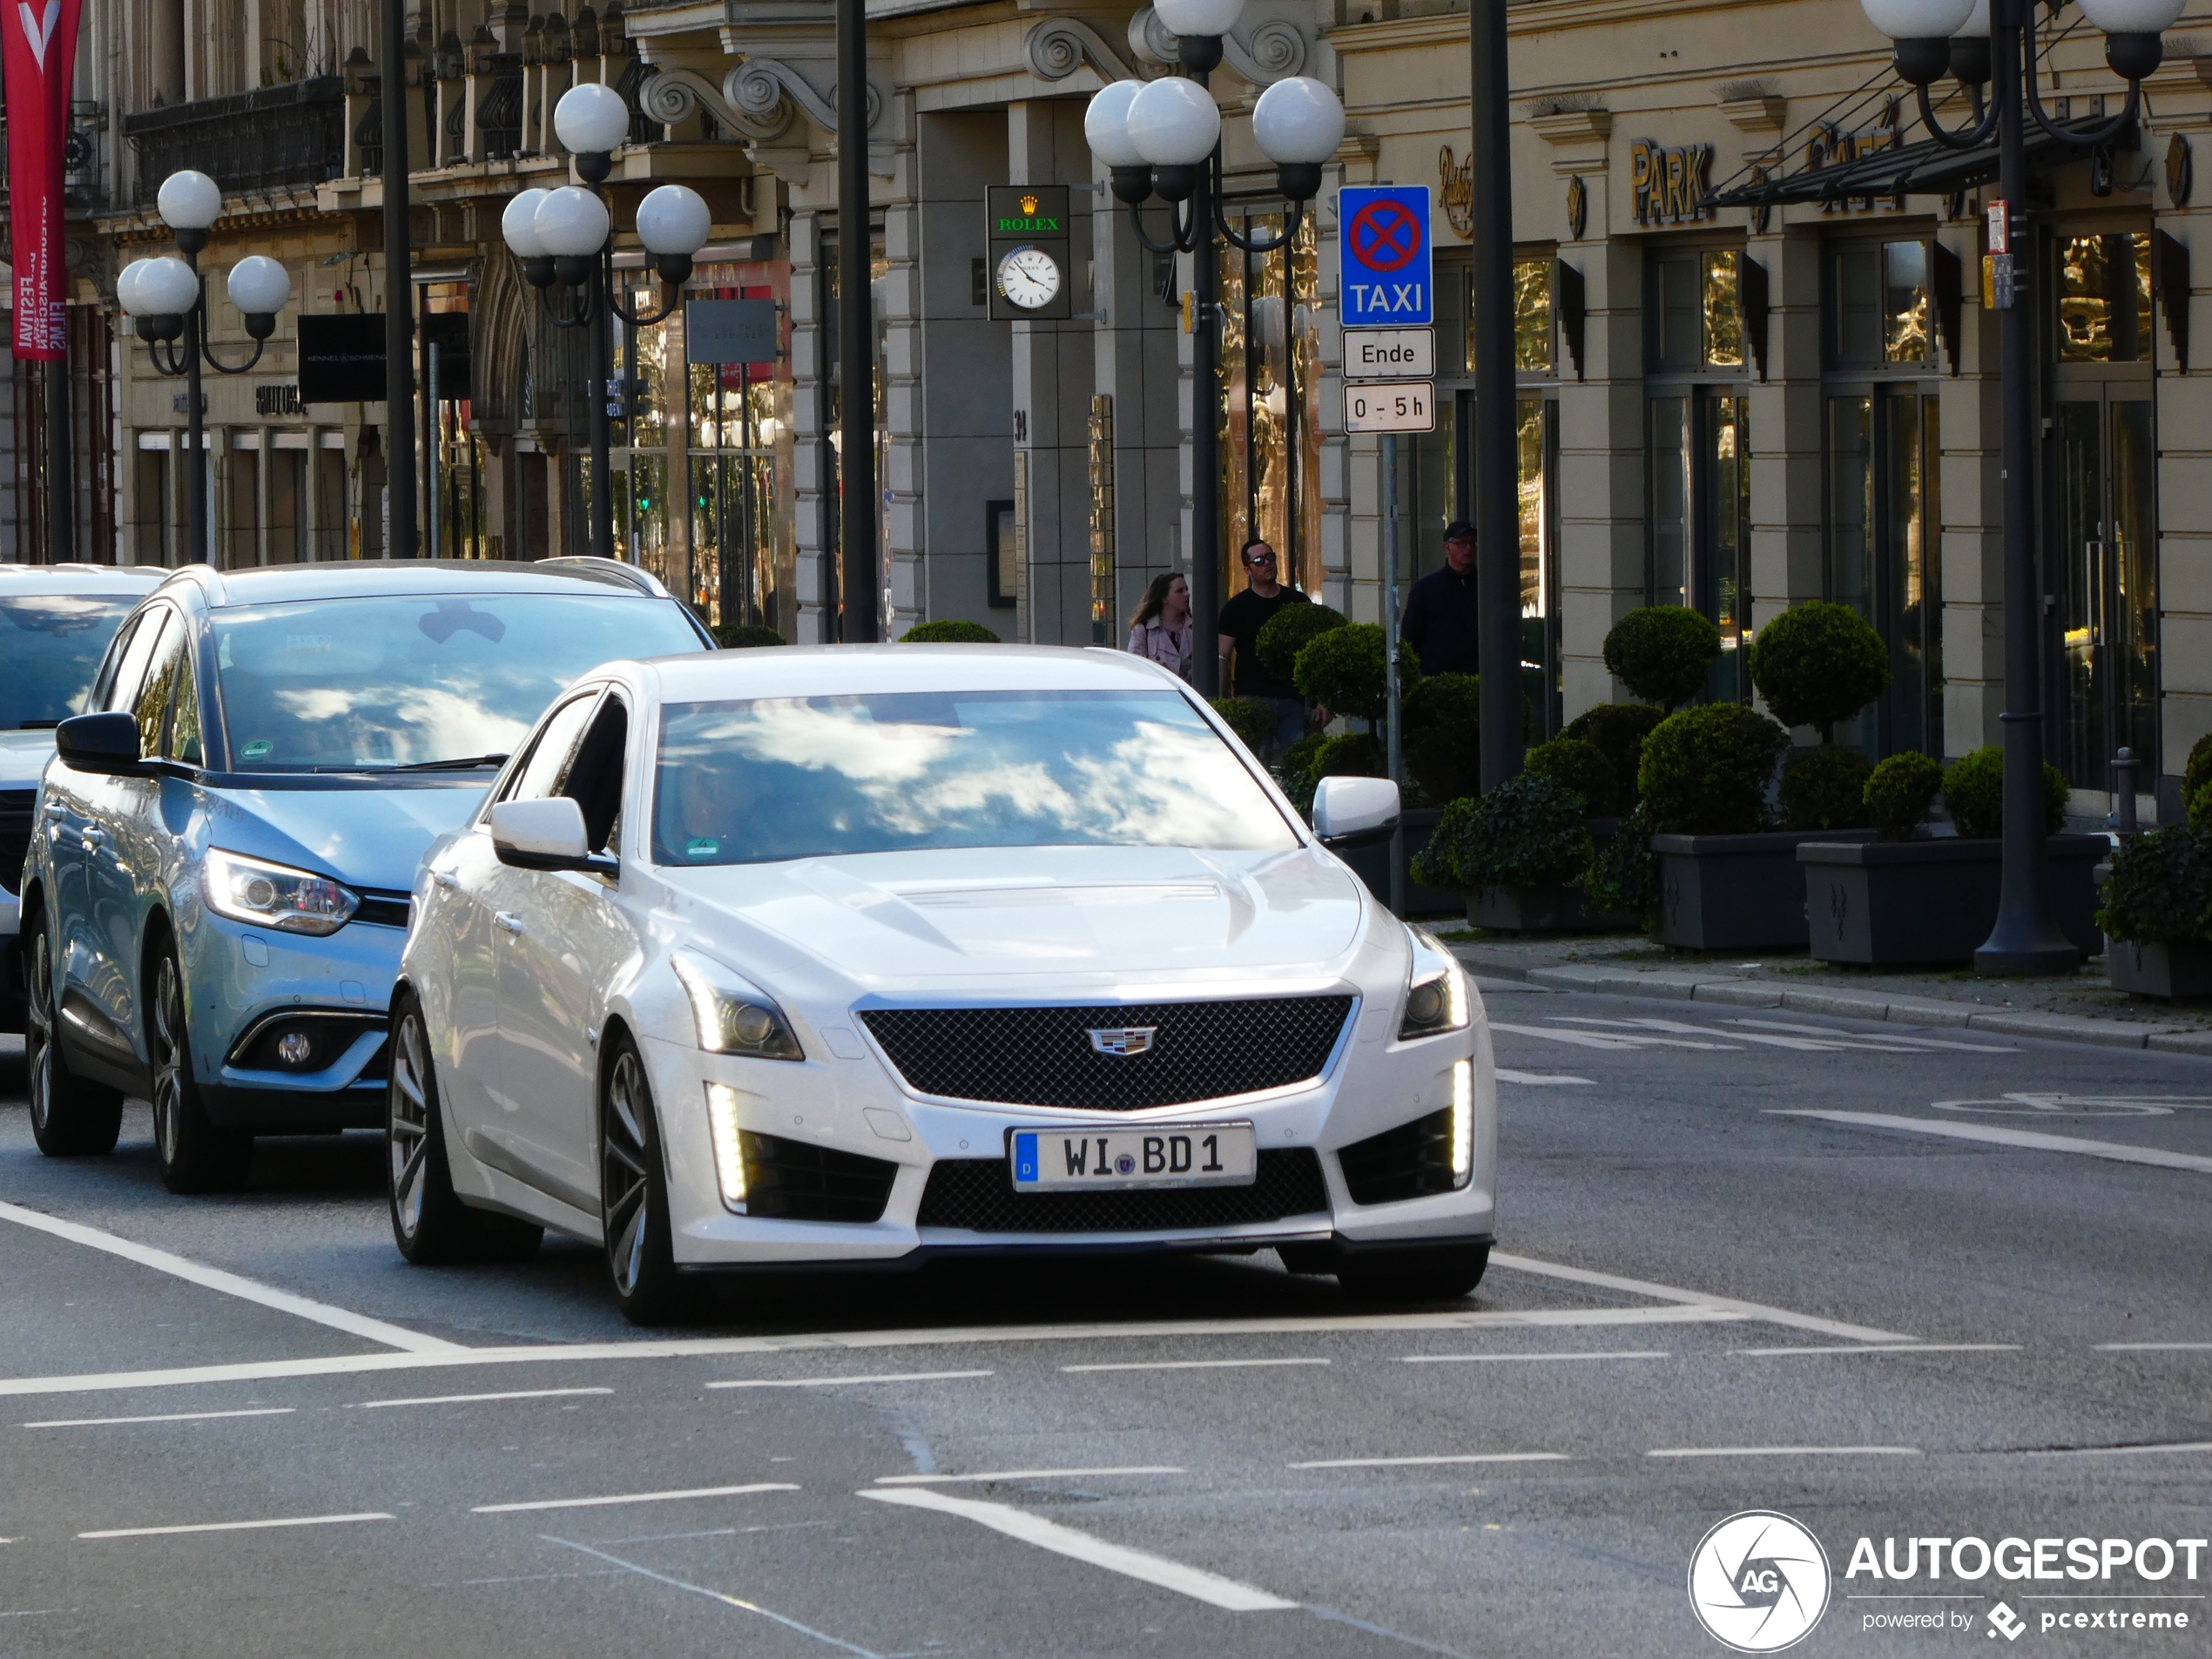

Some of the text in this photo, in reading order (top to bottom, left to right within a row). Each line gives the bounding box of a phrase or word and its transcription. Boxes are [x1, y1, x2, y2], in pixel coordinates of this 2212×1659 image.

[1630, 138, 1709, 224] PARK
[999, 218, 1059, 231] ROLEX
[1350, 284, 1421, 312] TAXI
[1362, 344, 1414, 363] Ende
[1022, 1163, 1031, 1175] D
[1064, 1138, 1112, 1176] WI
